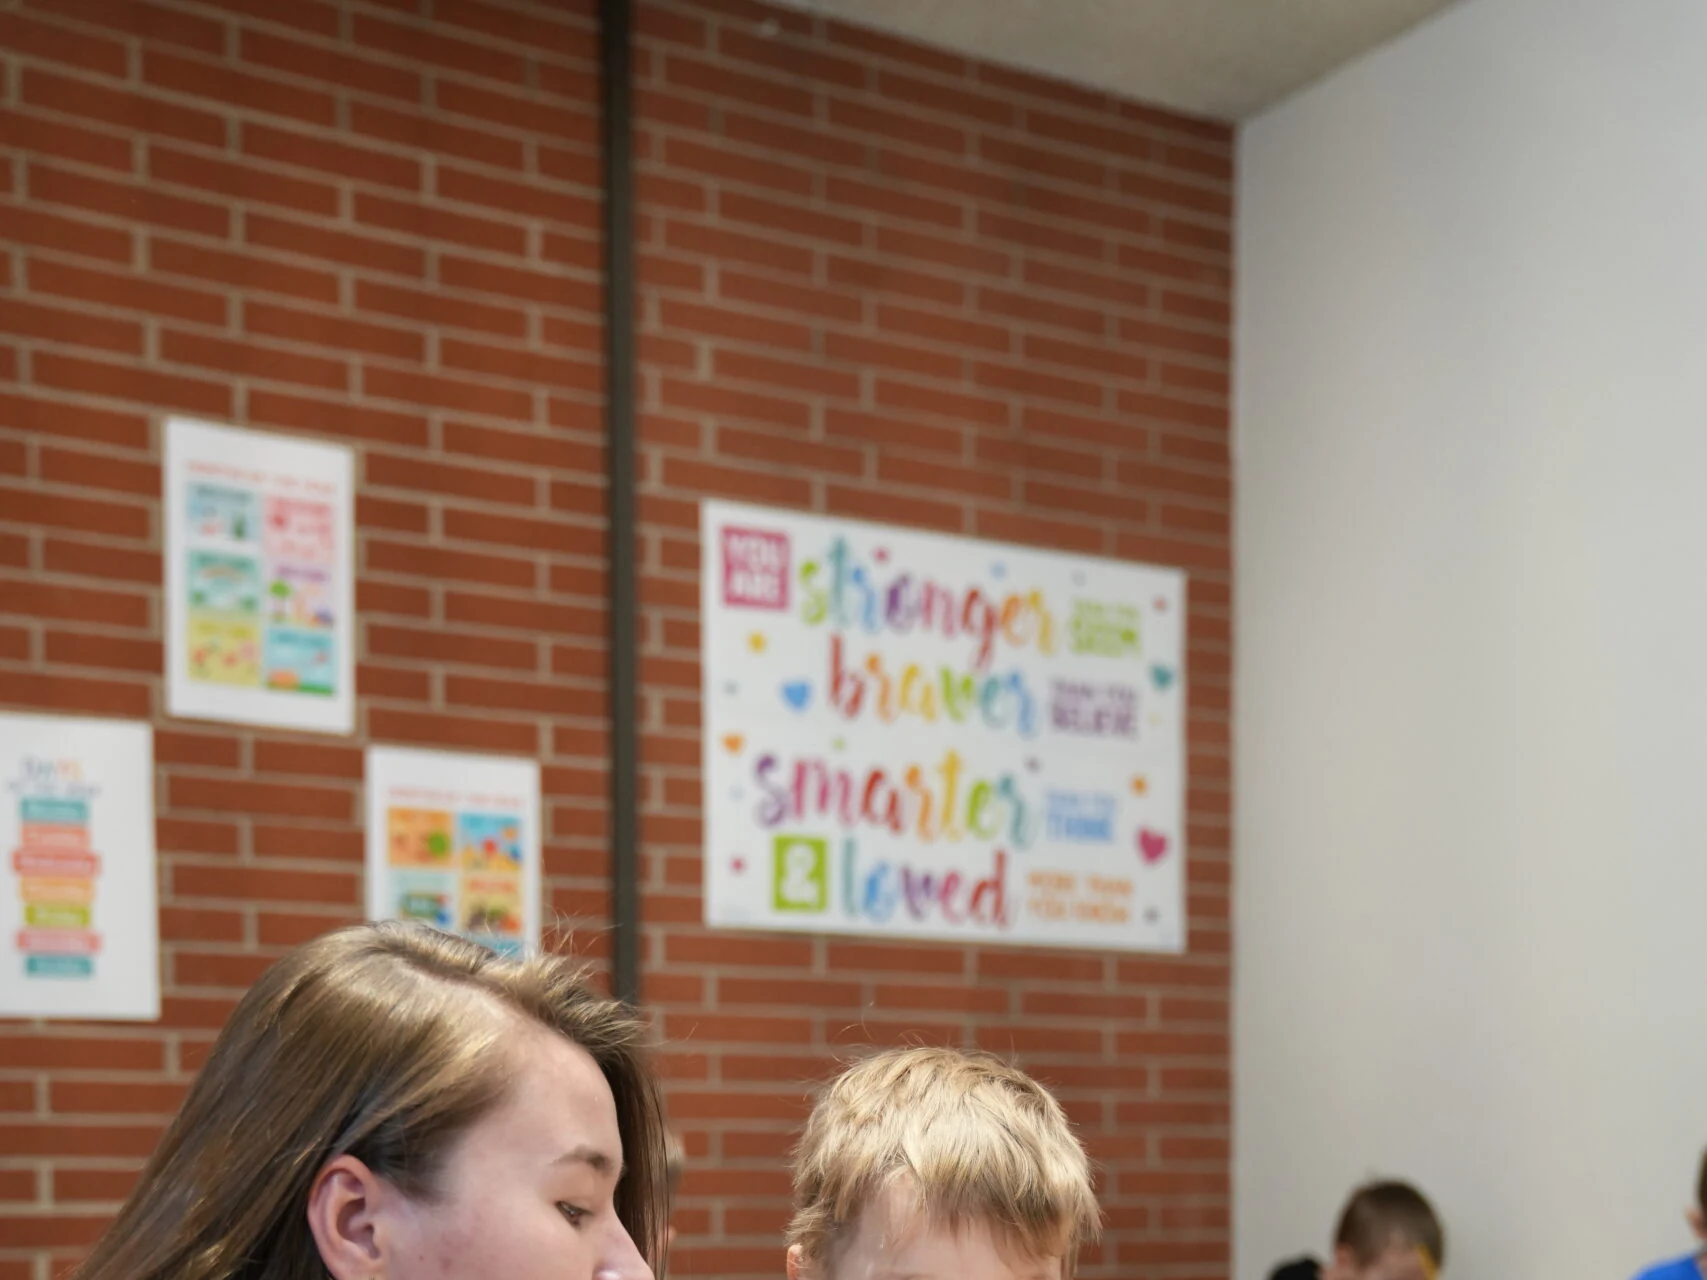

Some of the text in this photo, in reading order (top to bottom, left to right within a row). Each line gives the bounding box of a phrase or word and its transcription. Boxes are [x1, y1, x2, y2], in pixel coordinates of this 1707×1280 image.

[799, 535, 1053, 672] stronger
[829, 635, 1036, 738] braver
[756, 751, 1030, 849] smarter
[838, 838, 1012, 929] loved
